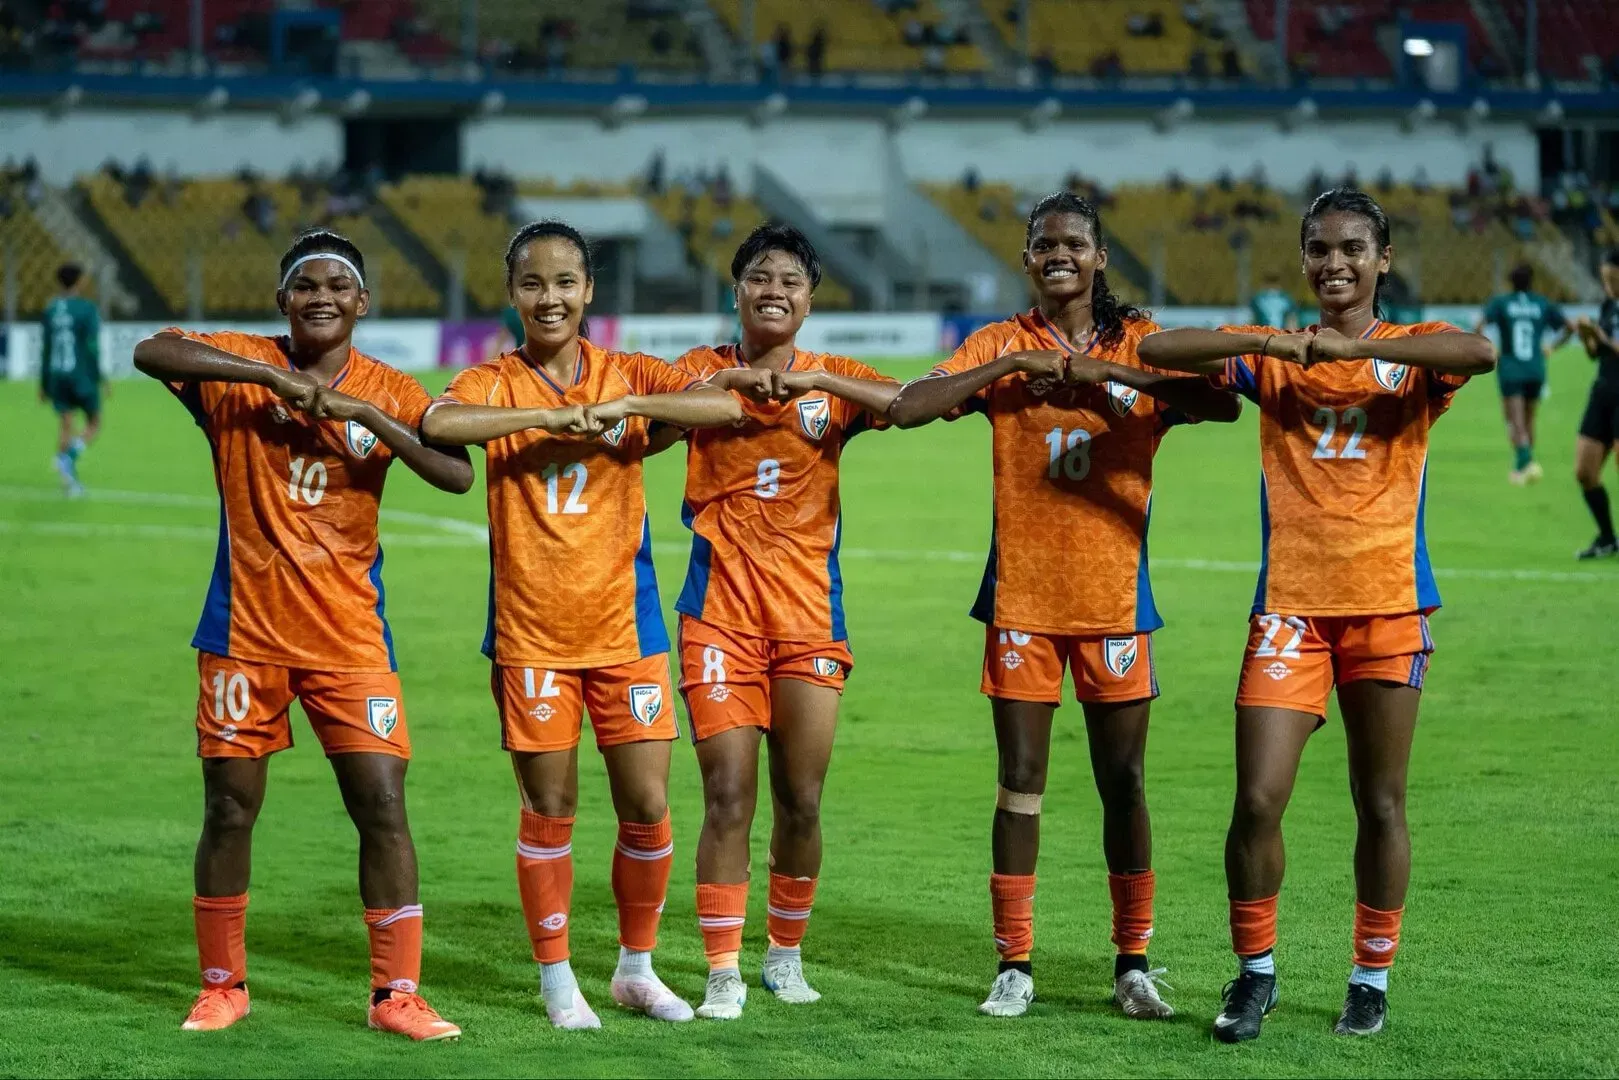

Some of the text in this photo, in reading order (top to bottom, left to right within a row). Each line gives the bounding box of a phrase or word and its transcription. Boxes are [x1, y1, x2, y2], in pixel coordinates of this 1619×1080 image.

[1045, 427, 1092, 481] 18
[1311, 407, 1367, 459] 22
[289, 457, 328, 506] 10
[542, 462, 588, 514] 12
[754, 459, 780, 498] 8
[1255, 614, 1308, 659] 22
[702, 643, 726, 684] 8
[214, 670, 250, 721] 10
